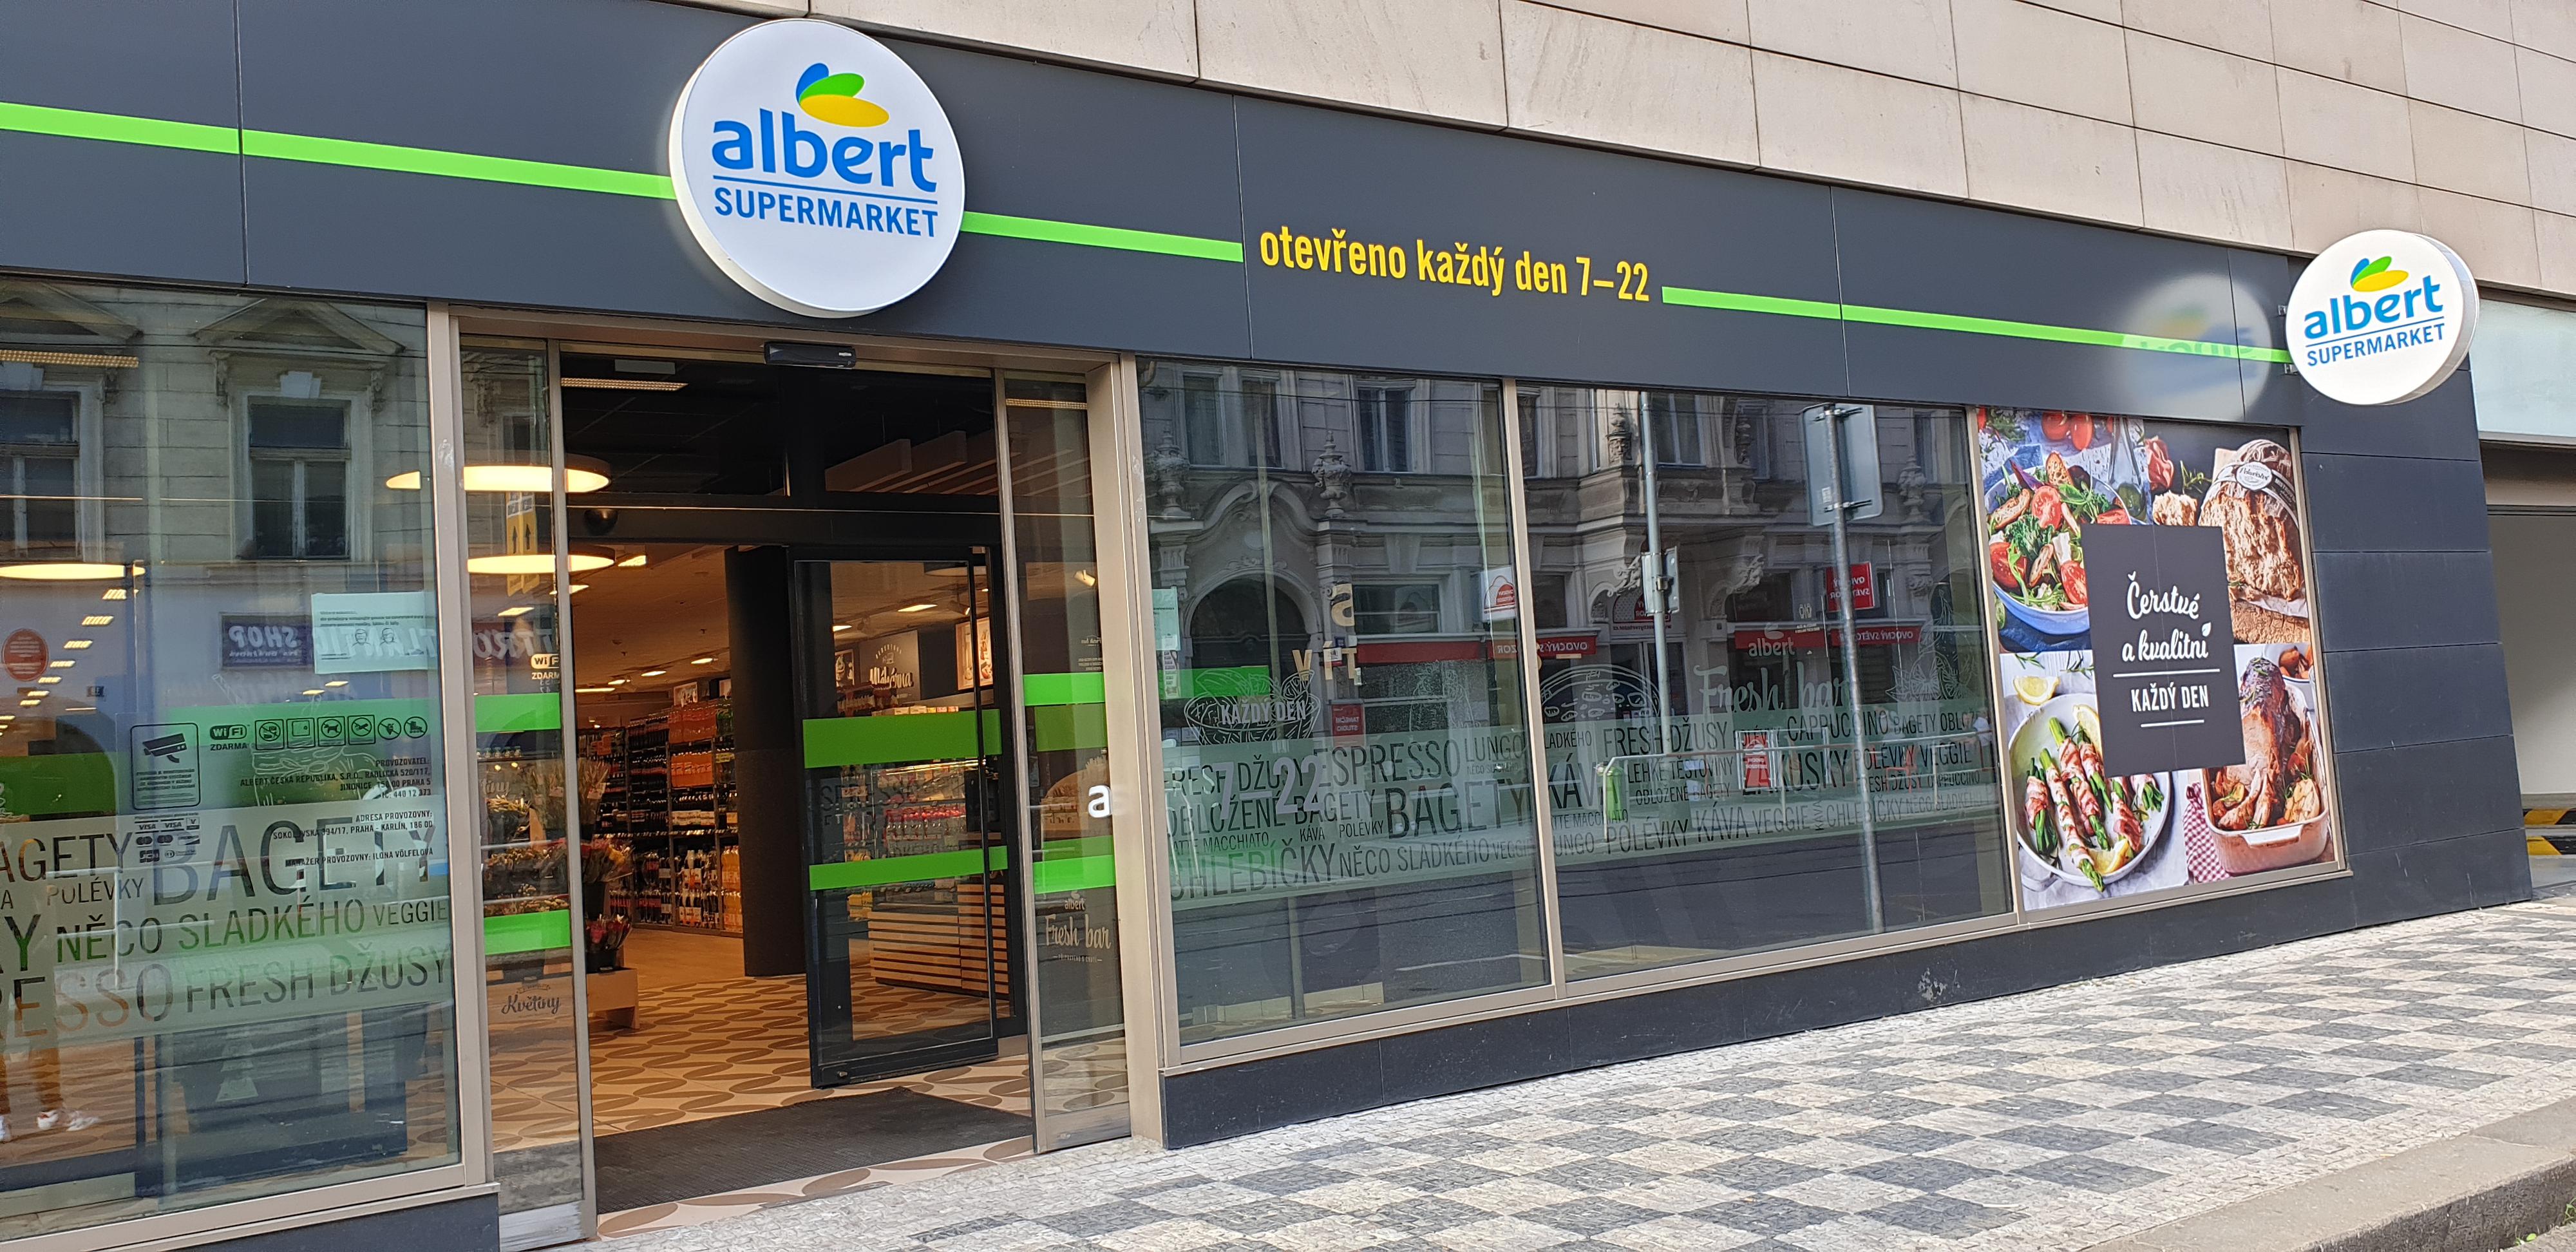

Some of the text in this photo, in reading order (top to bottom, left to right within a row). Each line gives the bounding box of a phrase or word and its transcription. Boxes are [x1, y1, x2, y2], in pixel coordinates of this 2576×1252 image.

[712, 108, 938, 193] albert
[714, 187, 938, 238] SUPERMARKET
[1260, 225, 1406, 279] otevřeno
[1416, 239, 1504, 297] každý
[1515, 251, 1568, 294] den
[2304, 274, 2445, 340] albert
[2306, 323, 2445, 367] SUPERMARKET
[2126, 570, 2200, 620] Čerstvé
[533, 655, 560, 667] WiF
[1748, 638, 1795, 658] albert
[2122, 624, 2211, 666] a kvalitní
[532, 672, 560, 680] ZDARM
[1693, 660, 1851, 715] Fresh bar
[1274, 700, 1307, 721] DEN
[2130, 683, 2210, 713] KAŽDÝ DEN
[210, 743, 247, 752] ZDARMA
[211, 725, 245, 738] WiFi
[1604, 725, 1664, 758] FRESH
[1669, 716, 1728, 752] DŽUSY
[1787, 710, 1888, 742] CAPPUCCINO
[1893, 712, 1936, 734] BAGETY
[1464, 734, 1524, 763] LUNGO
[240, 777, 268, 786] ALBERT
[1237, 754, 1305, 792] DŽUY
[1313, 739, 1461, 788] ESPRESSO
[1627, 756, 1667, 784] LEHKÉ
[1669, 755, 1734, 781] TĚSTOVINY
[1088, 785, 1112, 818] a
[1385, 777, 1528, 840] BAGETY
[1635, 782, 1730, 806] OBLOŽENÉ BAGETY
[350, 824, 374, 834] PRAHA
[410, 820, 422, 830] 186
[355, 810, 433, 823] ADRESA PROVOZOVNY:
[1607, 817, 1689, 855] POLÉVKY
[1696, 801, 1750, 843] KÁVA
[1751, 804, 1810, 835] VEGGIE
[1203, 831, 1269, 853] MACCHIATO
[1300, 824, 1325, 842] KÁVA
[1339, 819, 1384, 839] POLÉVKY
[321, 853, 372, 864] PROVOZOVNY:
[1339, 842, 1391, 878] NĚCO
[1397, 833, 1490, 872] SLADKÉHO
[1065, 898, 1085, 911] albert
[56, 913, 163, 963] NĚCO
[178, 895, 365, 951] SLADKÉHO
[372, 899, 449, 927] VEGGIE
[1045, 913, 1112, 950] Fresh bar
[329, 942, 450, 996] DŽUSY
[501, 994, 560, 1015] Květiny
